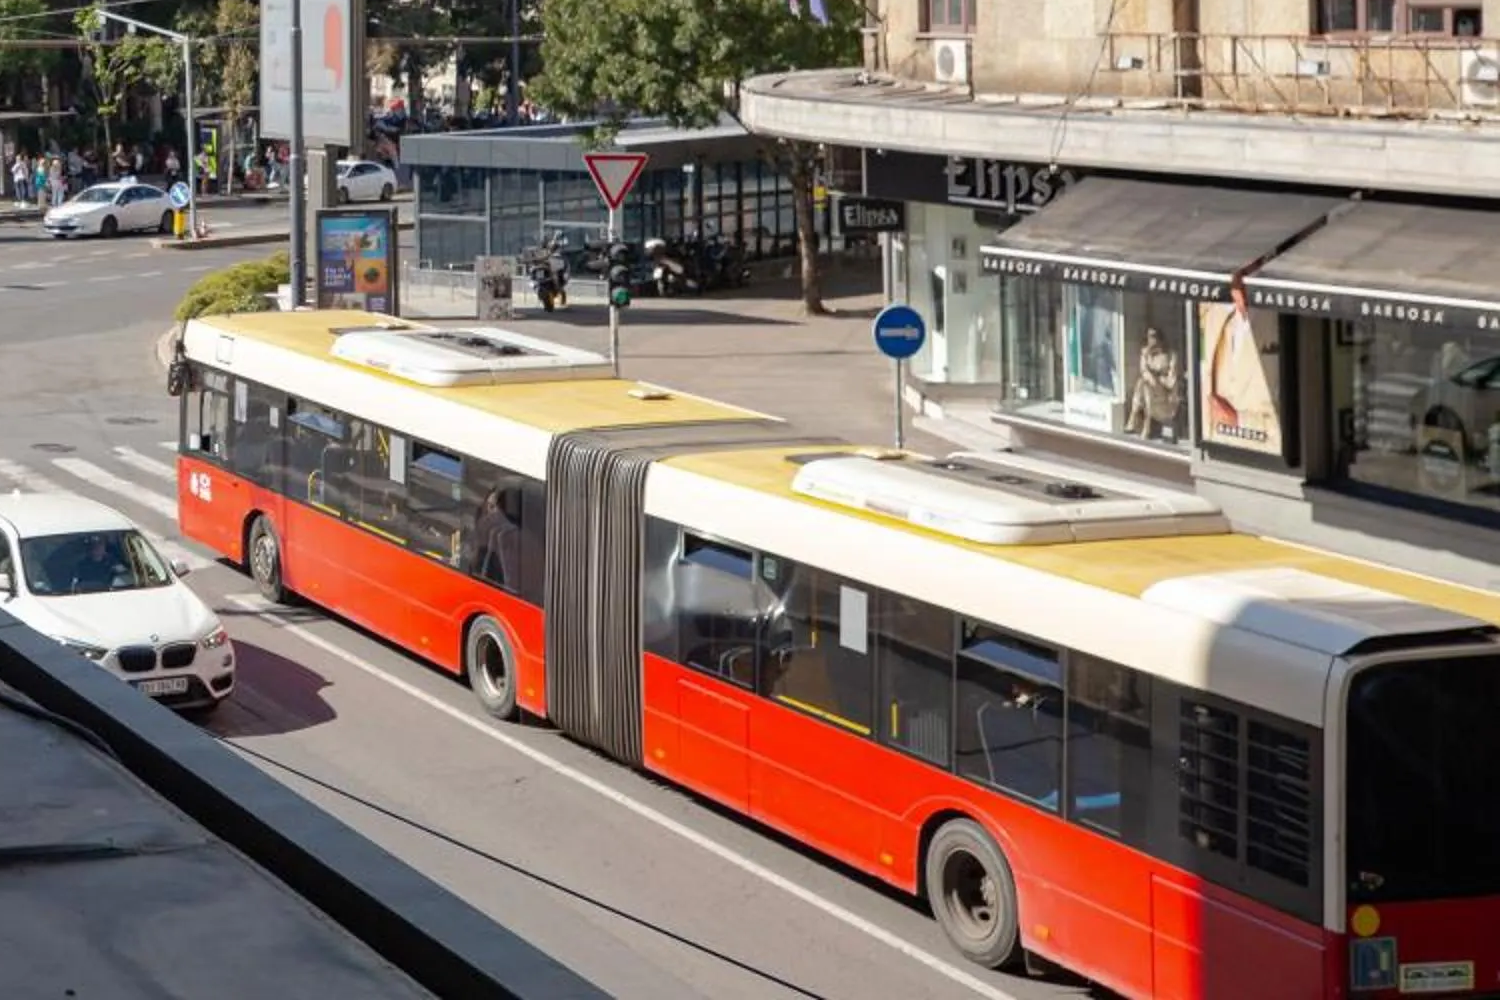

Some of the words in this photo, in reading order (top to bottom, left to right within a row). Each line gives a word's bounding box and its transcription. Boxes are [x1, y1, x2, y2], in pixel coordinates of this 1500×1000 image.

[843, 203, 899, 228] Elipsa
[983, 256, 1043, 276] BARBOSA
[1063, 266, 1128, 287] BARBOSA
[1149, 277, 1221, 299] BARBOSA
[1254, 290, 1332, 312] BARBOSA
[1361, 301, 1445, 325] BARBOSA
